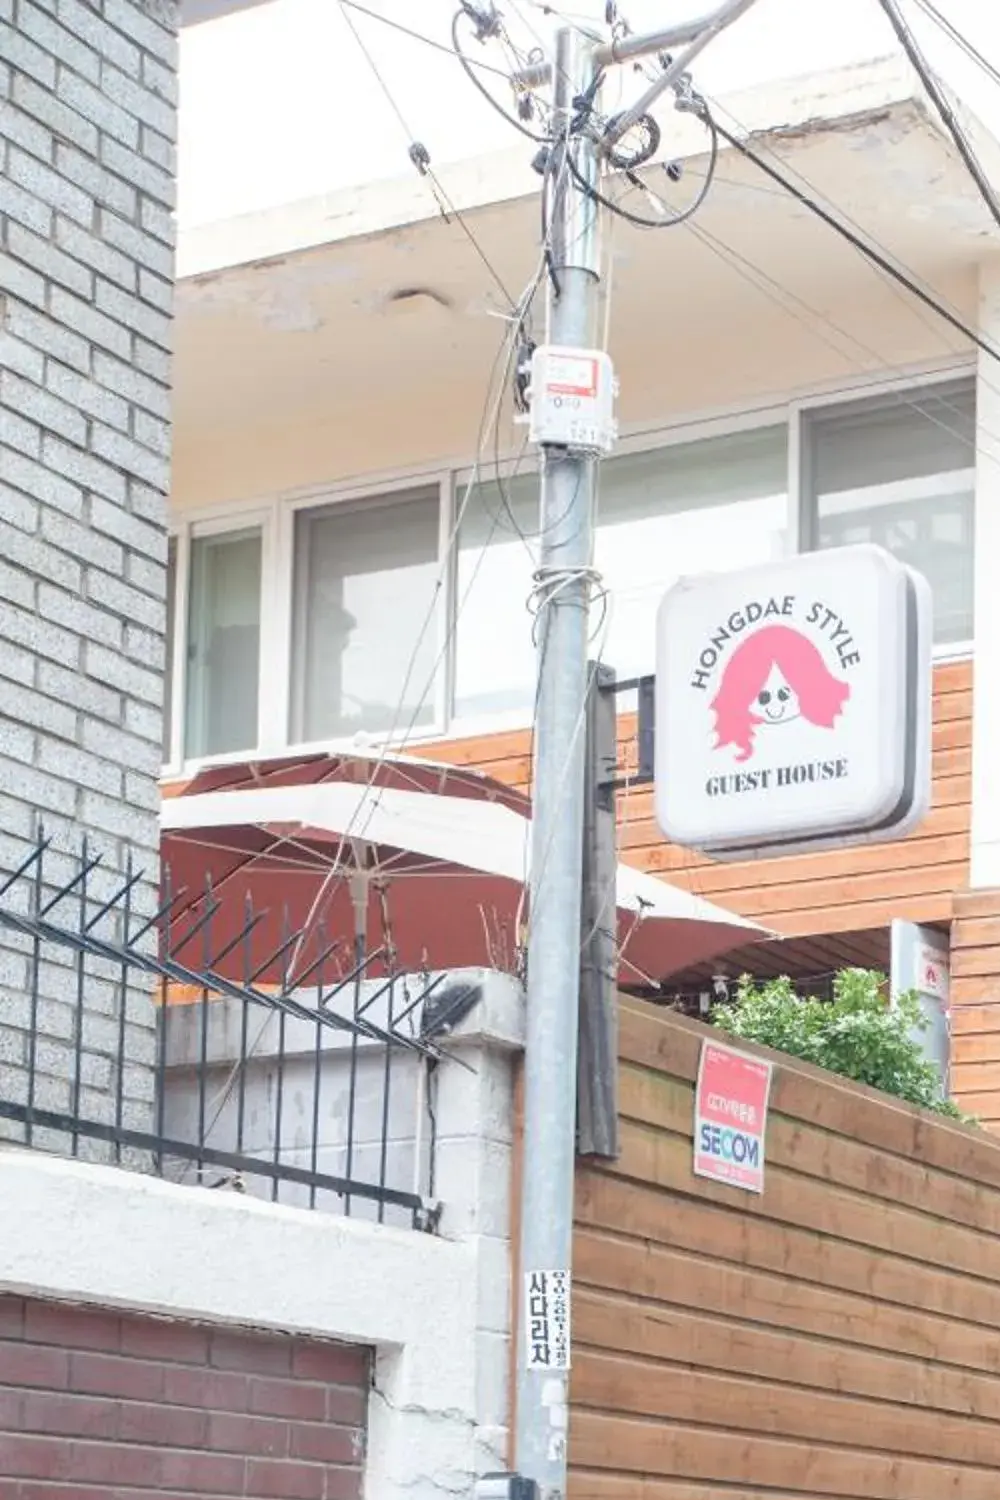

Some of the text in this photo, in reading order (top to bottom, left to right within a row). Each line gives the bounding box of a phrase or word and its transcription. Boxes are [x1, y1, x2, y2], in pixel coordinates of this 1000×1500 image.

[691, 595, 861, 690] HONGDAE STYLE
[705, 758, 849, 797] GUEST HOUSE
[701, 1124, 760, 1169] SECOM
[529, 1271, 551, 1366] 사다리차
